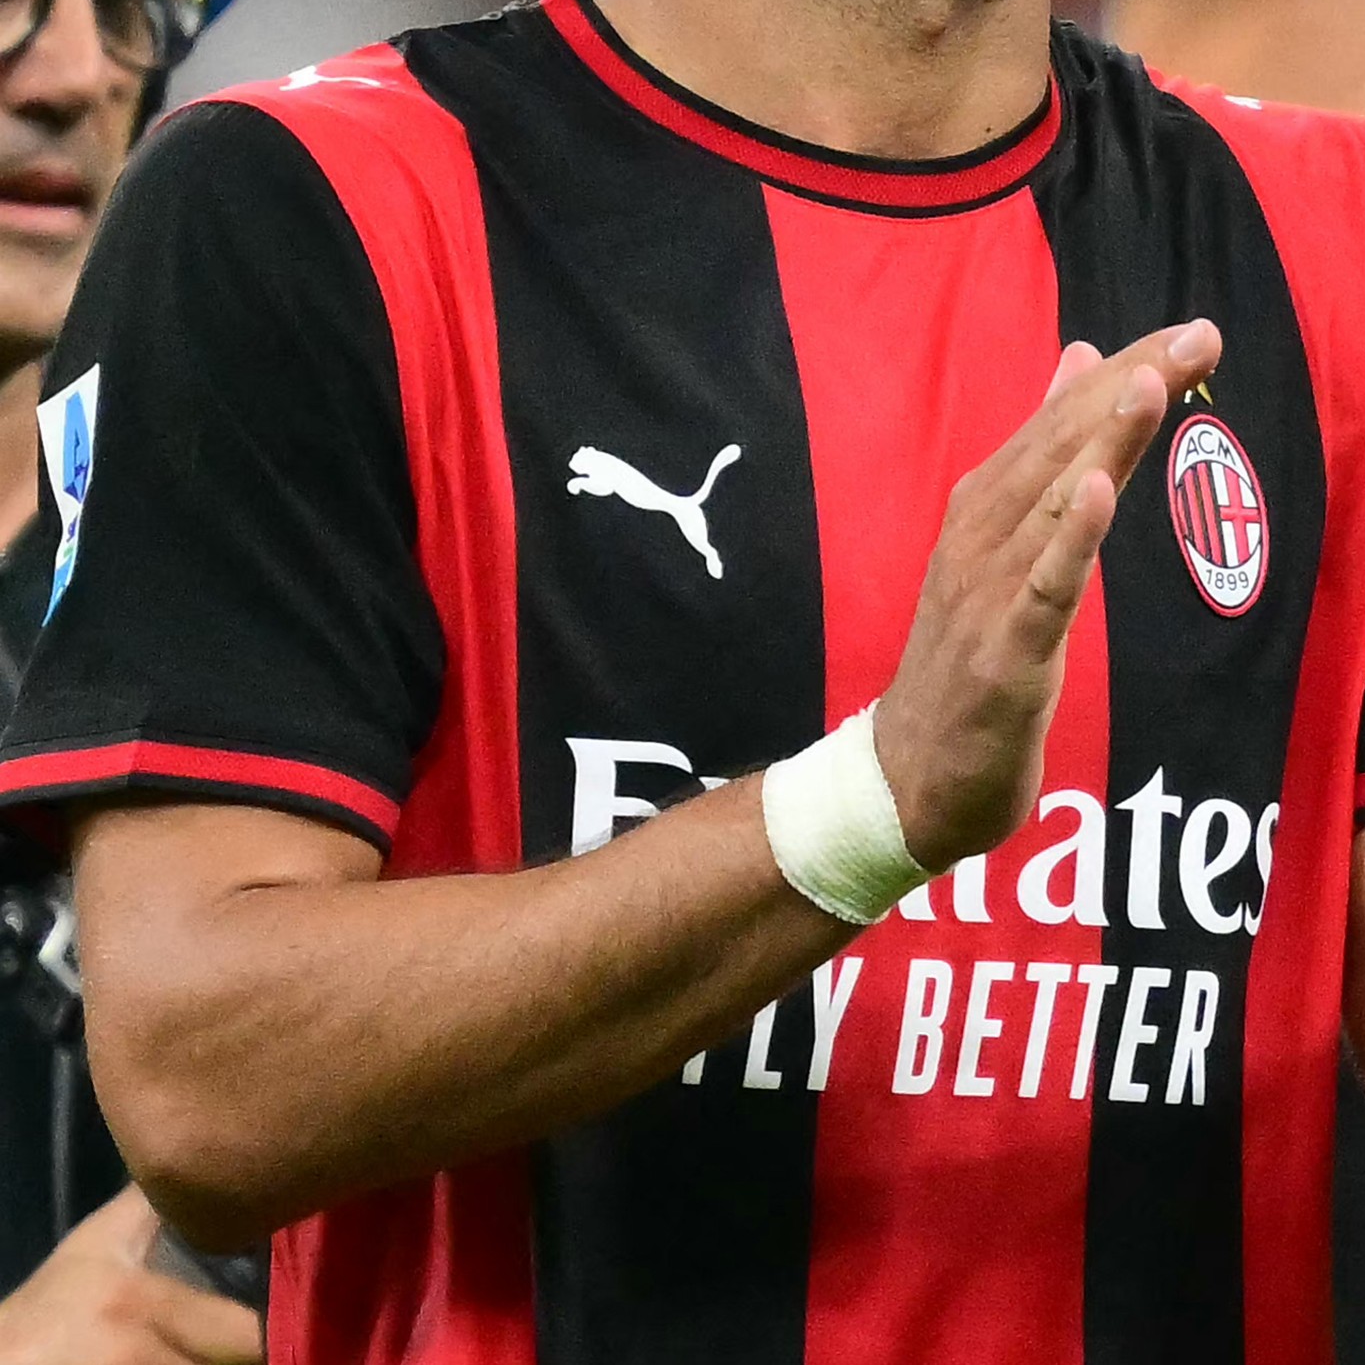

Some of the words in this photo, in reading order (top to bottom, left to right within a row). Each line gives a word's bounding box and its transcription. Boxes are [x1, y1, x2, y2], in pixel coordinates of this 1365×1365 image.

[1183, 430, 1236, 465] ACM
[1204, 569, 1250, 591] 1899
[682, 956, 865, 1092] LY
[891, 958, 1221, 1106] BETTER
